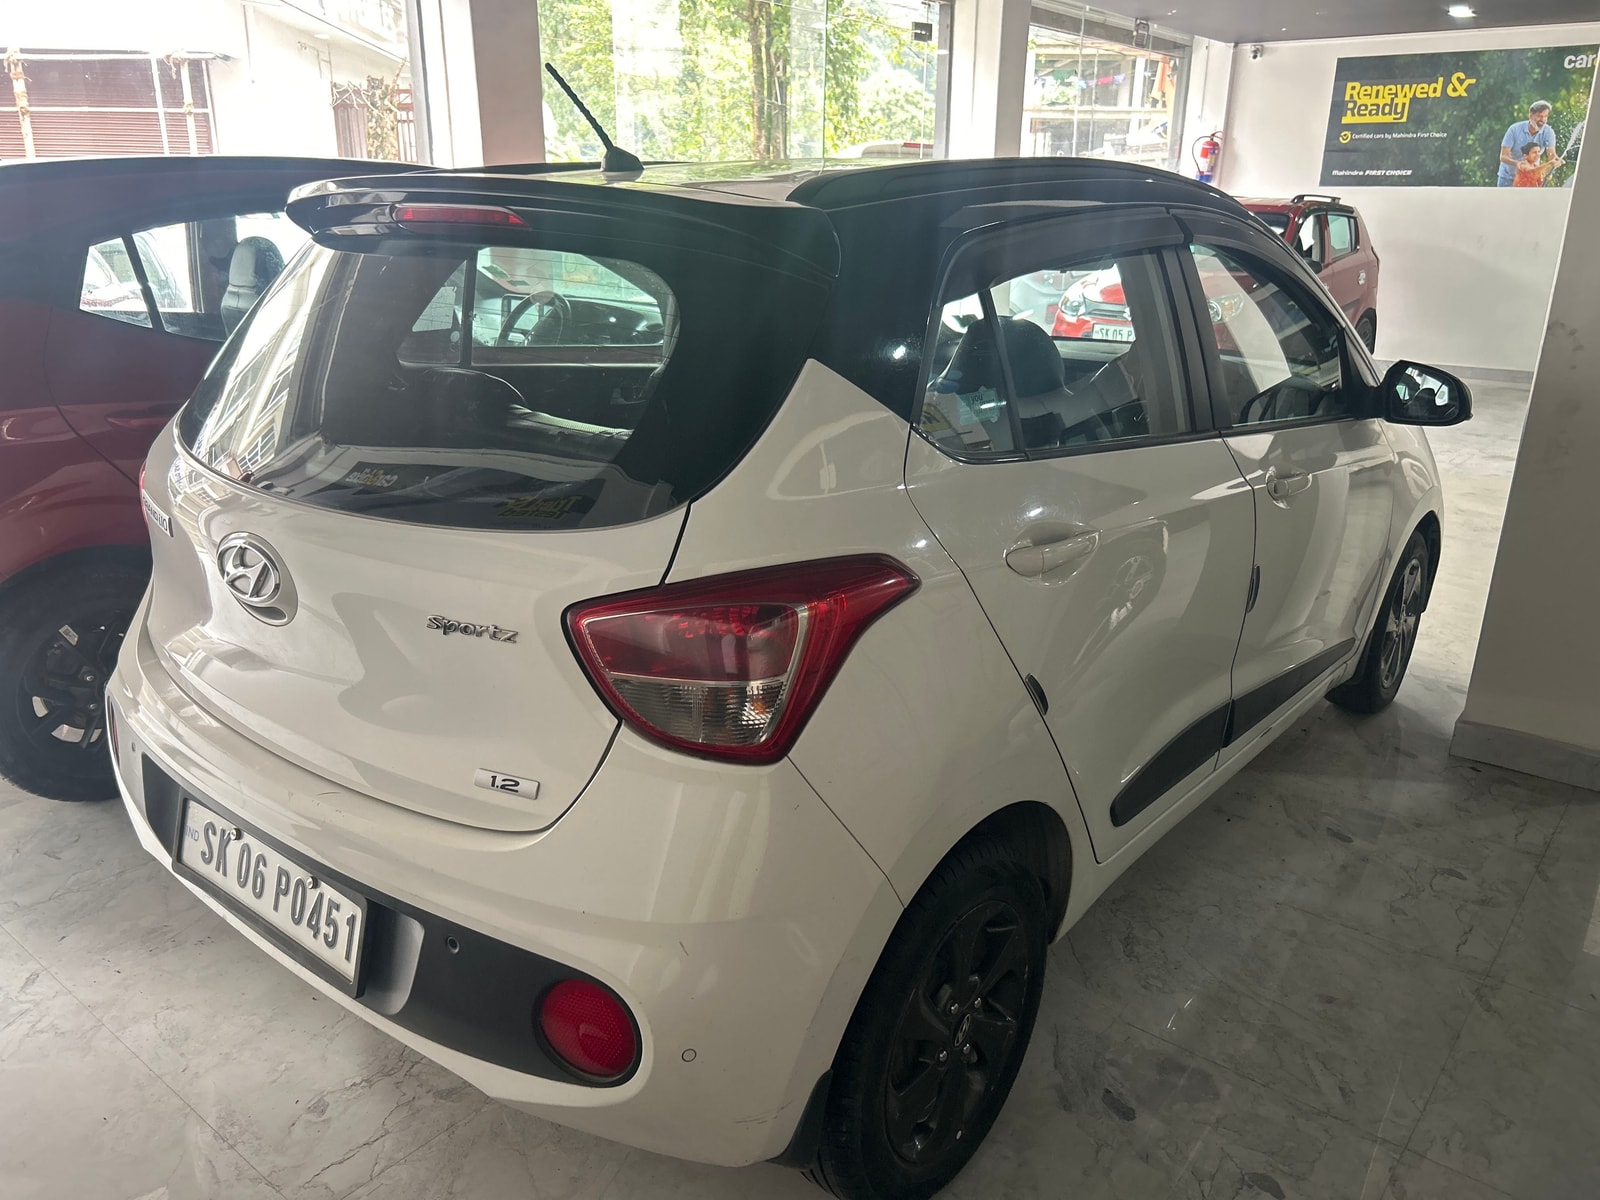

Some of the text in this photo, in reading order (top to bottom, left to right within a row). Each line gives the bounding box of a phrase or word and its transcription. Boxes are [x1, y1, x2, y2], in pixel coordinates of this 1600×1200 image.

[1345, 71, 1476, 101] Renewed &
[1344, 100, 1407, 121] Ready
[426, 614, 519, 644] Sportz
[490, 775, 520, 793] 1.2
[200, 820, 357, 962] SK 06 P0451
